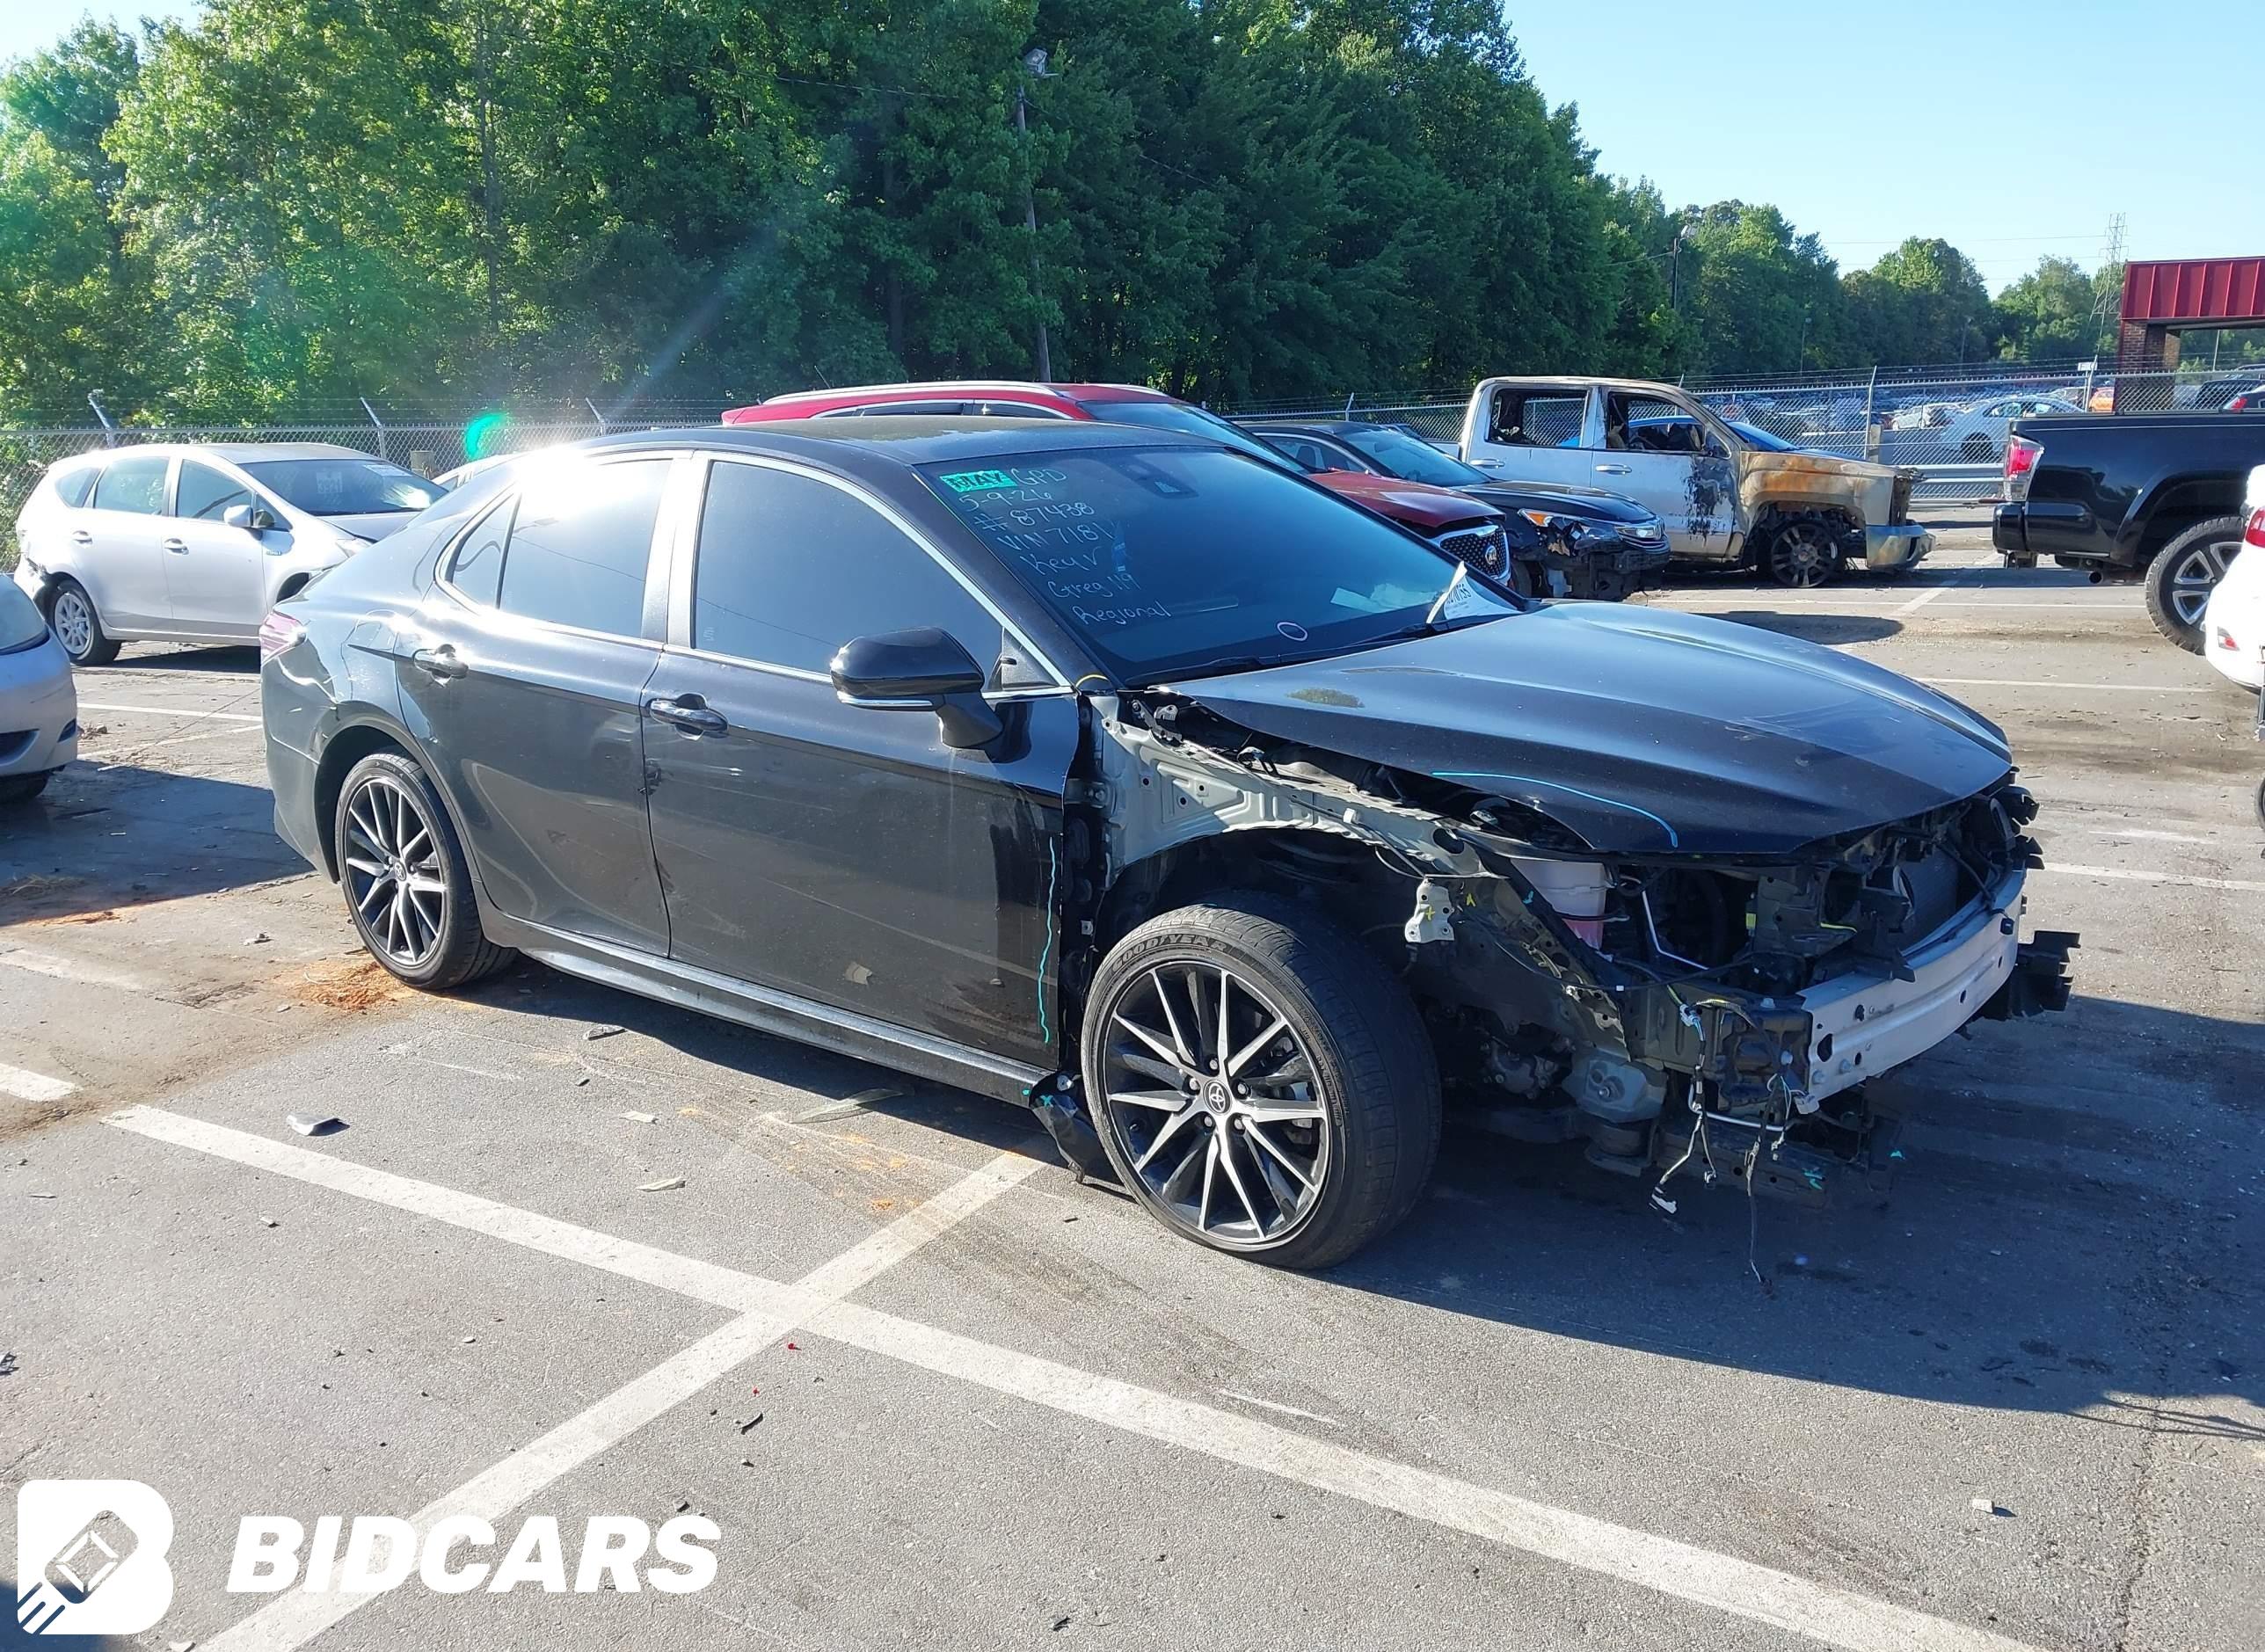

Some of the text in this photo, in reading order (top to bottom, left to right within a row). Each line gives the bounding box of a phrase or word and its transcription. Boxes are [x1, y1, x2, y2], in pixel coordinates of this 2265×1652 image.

[1010, 467, 1068, 485] GPD
[997, 533, 1049, 551] VIN
[1047, 580, 1113, 600] Greg
[1072, 600, 1173, 626] Regional
[1111, 934, 1228, 972] GOODYEAR
